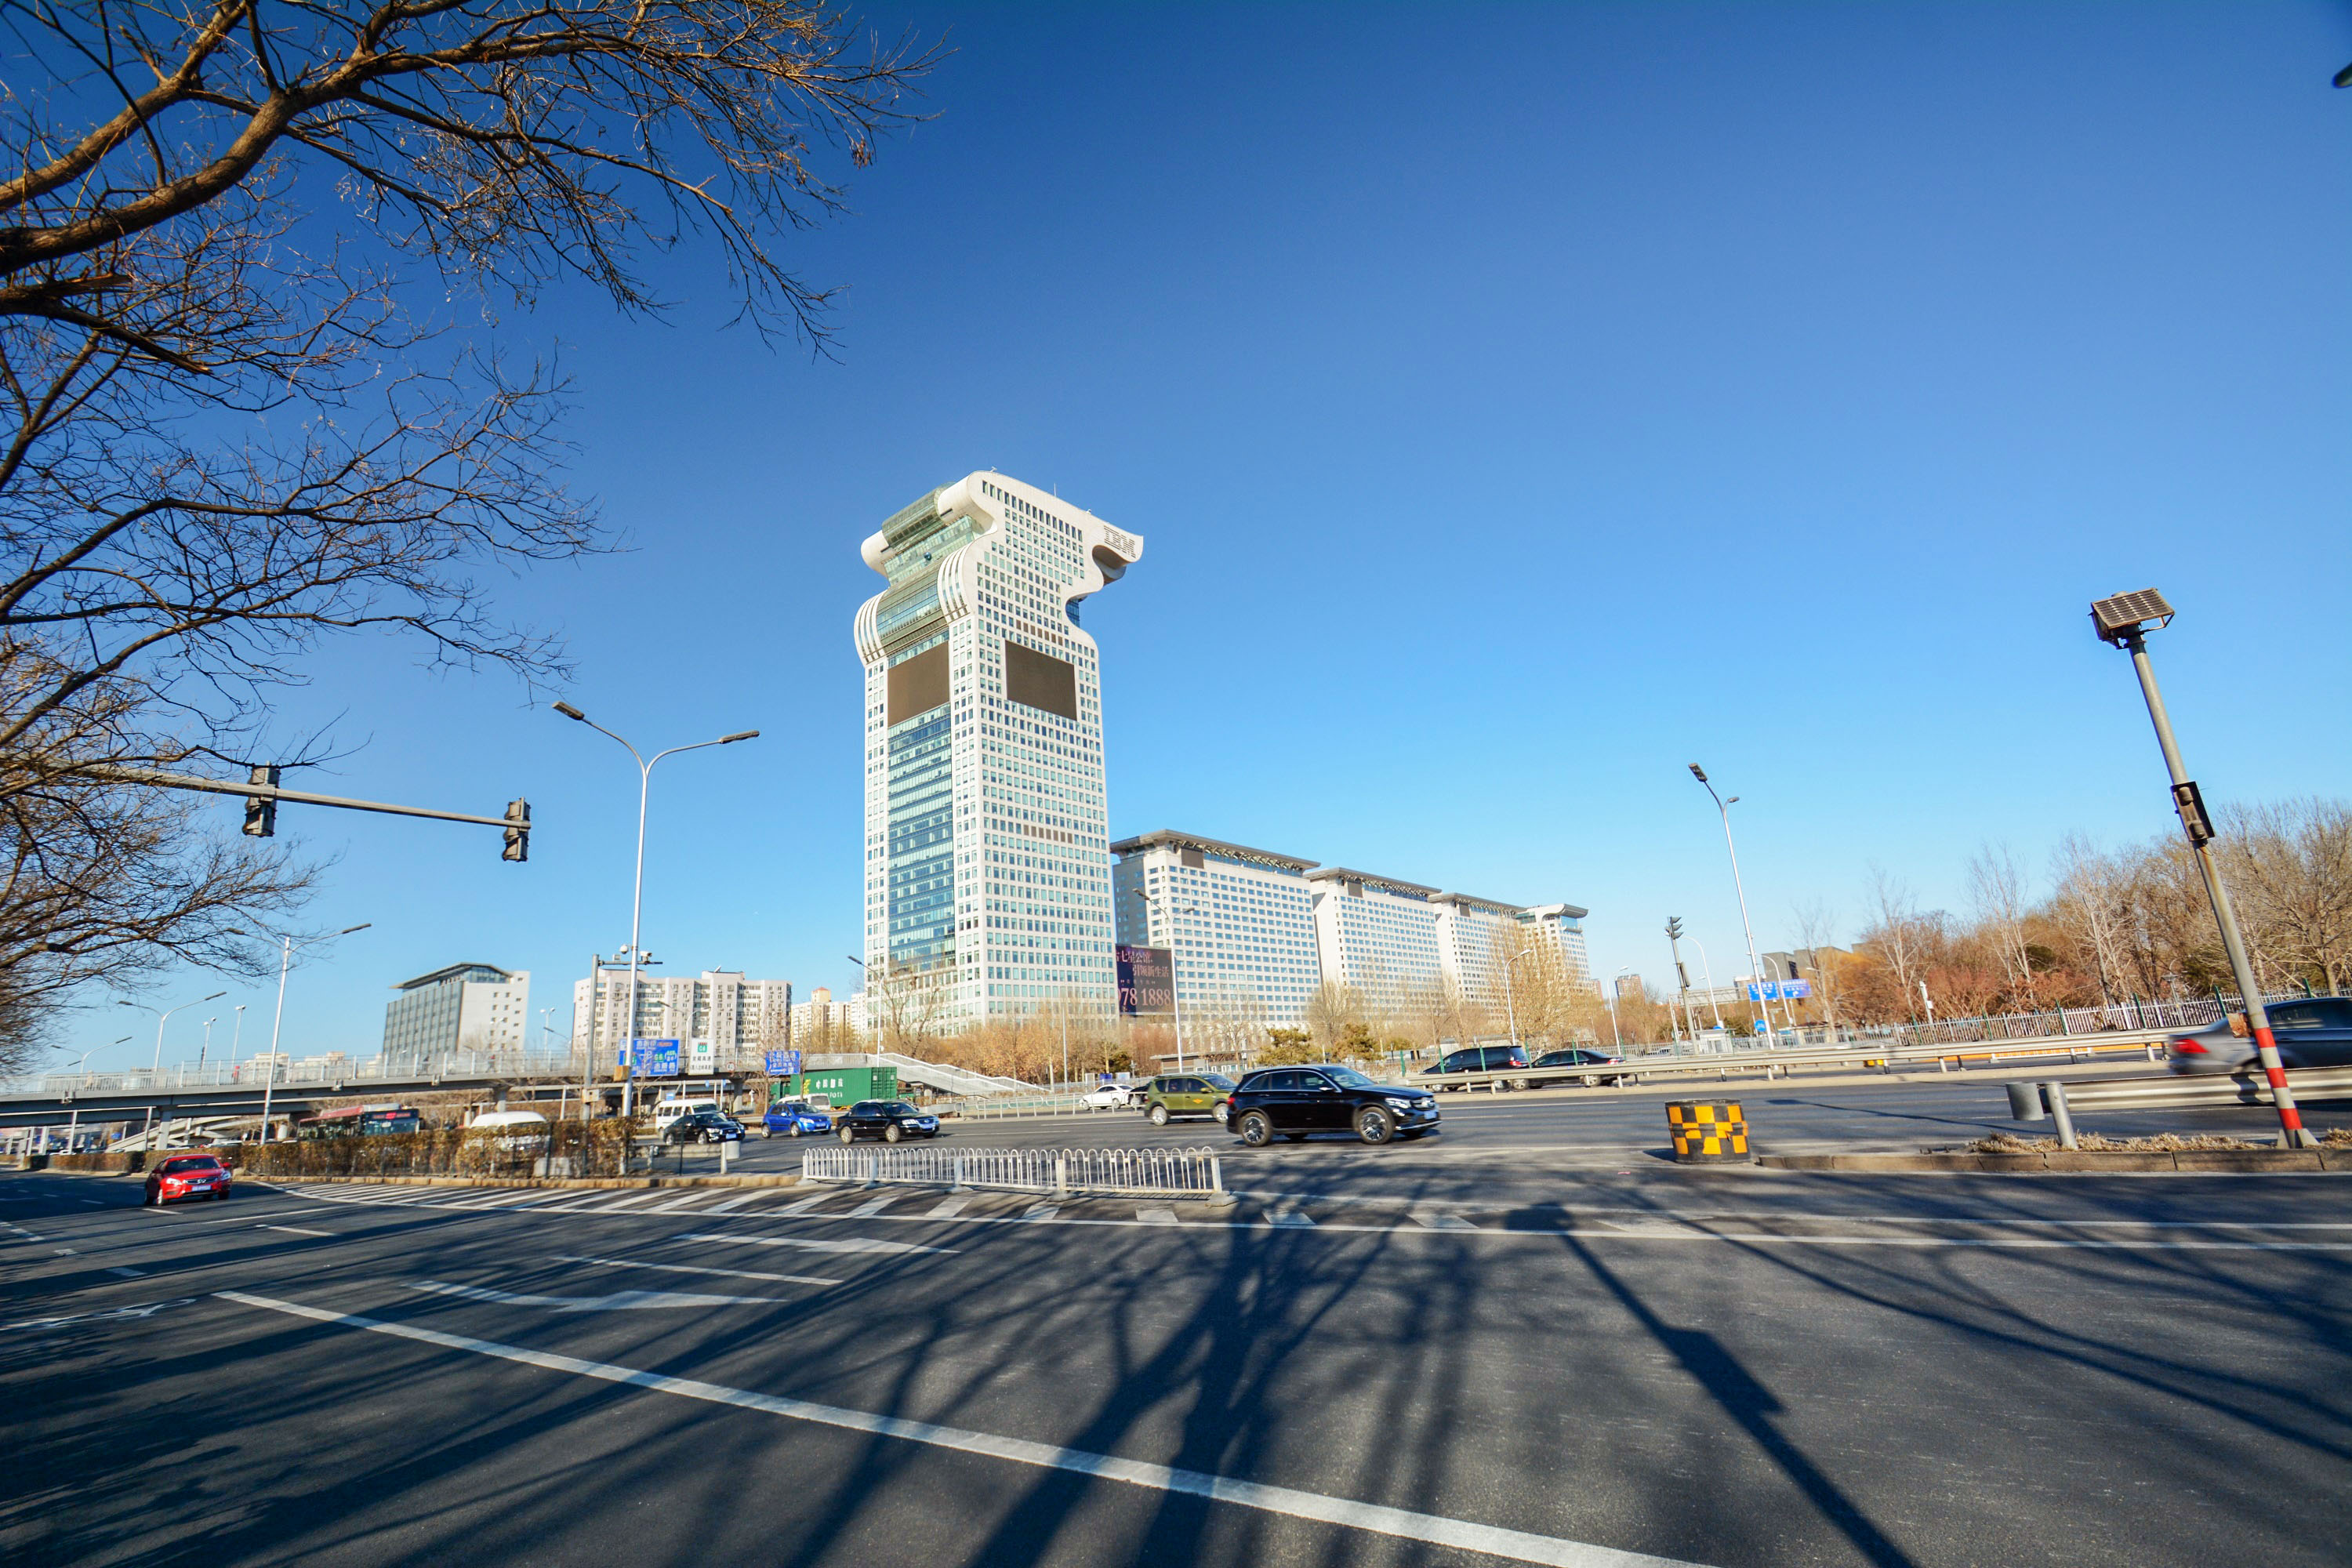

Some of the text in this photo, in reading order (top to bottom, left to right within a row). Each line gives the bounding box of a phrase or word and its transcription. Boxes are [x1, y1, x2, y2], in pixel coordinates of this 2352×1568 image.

[1103, 524, 1136, 558] IBM
[1132, 964, 1169, 978] 引领新生活
[1141, 988, 1171, 1006] 1888
